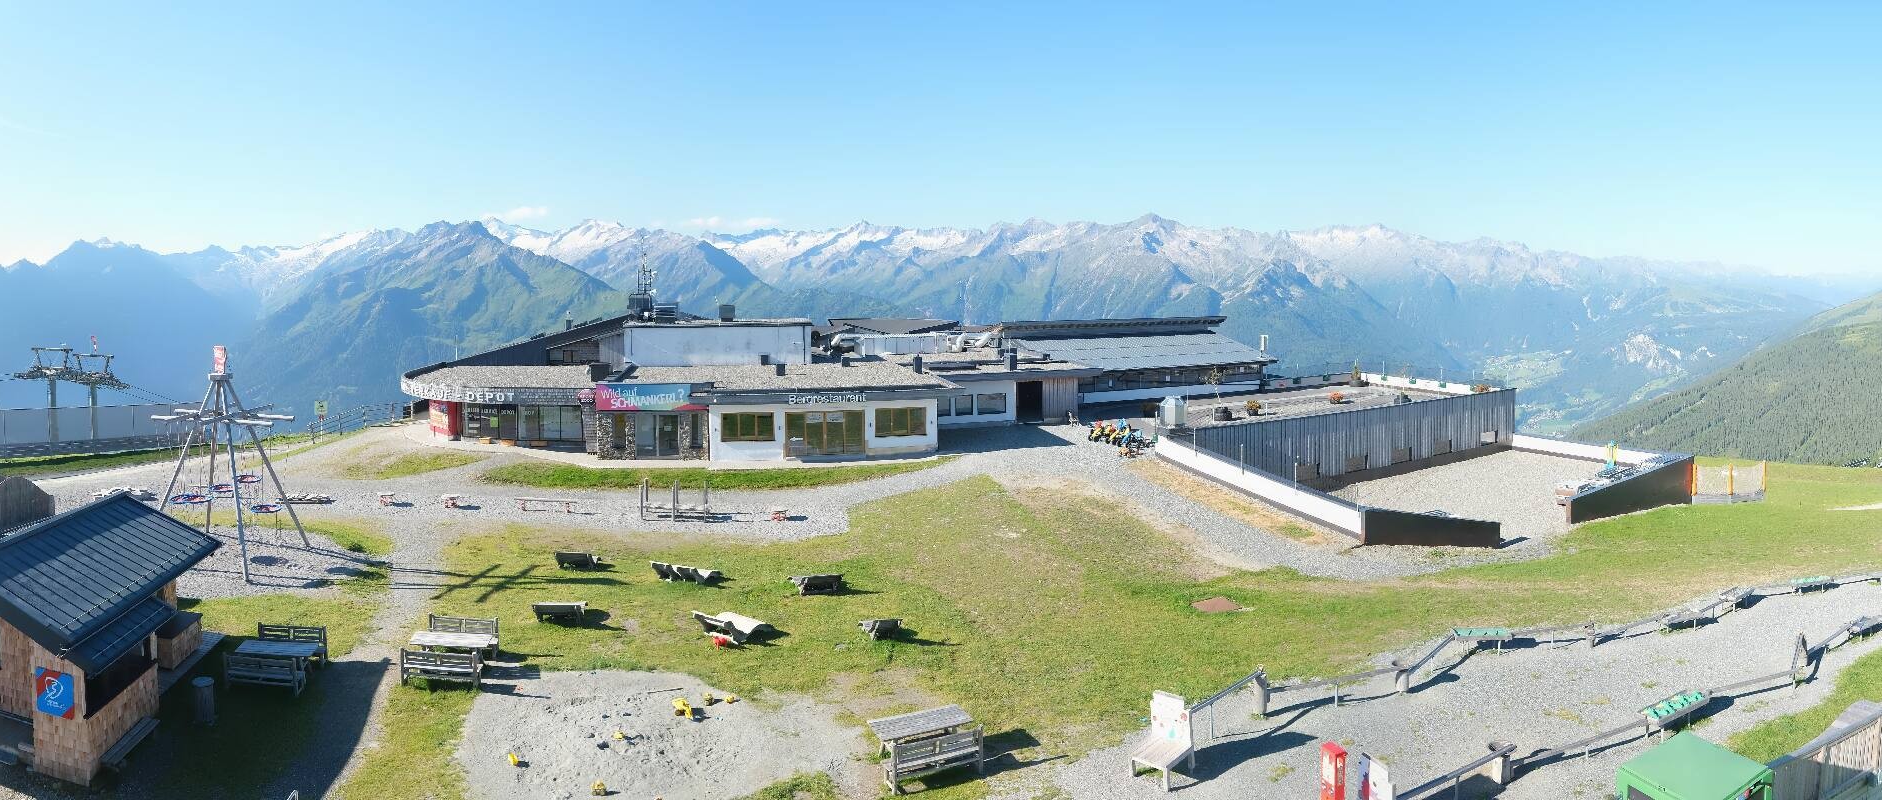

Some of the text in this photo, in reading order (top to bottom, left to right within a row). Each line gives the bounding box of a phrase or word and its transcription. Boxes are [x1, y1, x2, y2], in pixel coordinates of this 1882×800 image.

[466, 391, 515, 402] DEPOT
[601, 387, 637, 399] Wild auf
[610, 389, 685, 408] SCHMANKERL?
[788, 393, 867, 405] Bergrestaurant
